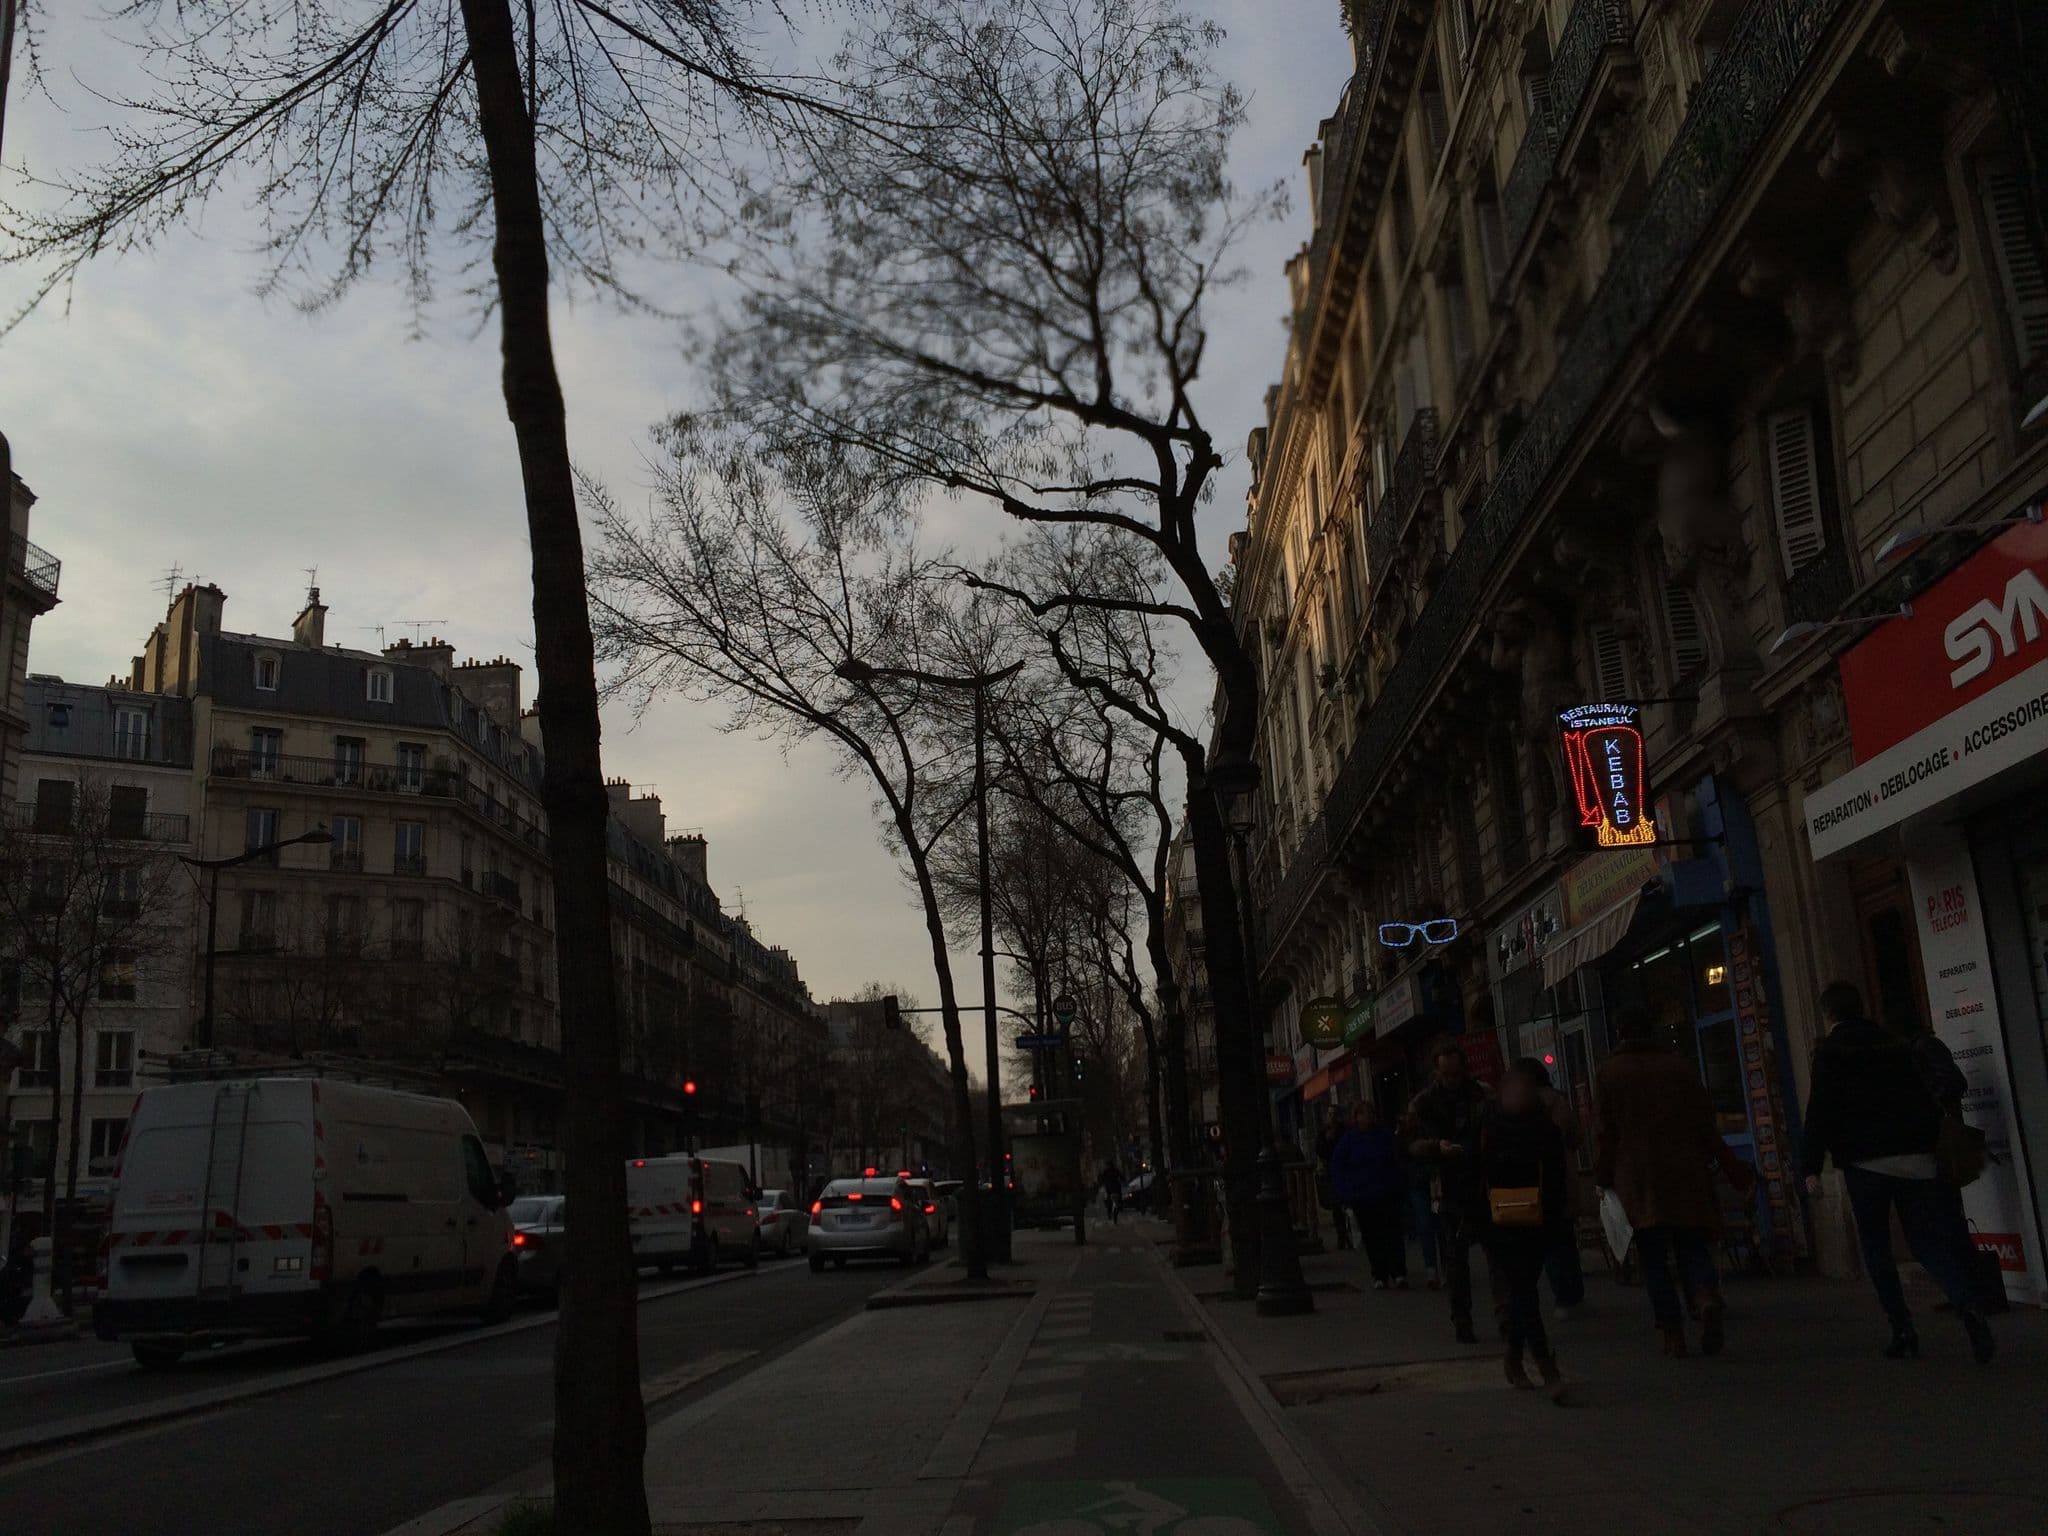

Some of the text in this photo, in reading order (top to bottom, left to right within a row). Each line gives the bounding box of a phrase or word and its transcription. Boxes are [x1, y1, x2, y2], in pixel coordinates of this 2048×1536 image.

[1560, 703, 1638, 722] RESTAURANT
[1570, 716, 1632, 728] ISTANBUL
[1604, 738, 1631, 824] KEBAB
[1813, 790, 1872, 835] REPARATION
[1881, 747, 1950, 801] DEBLOCAGE
[1928, 885, 1965, 919] PARIS
[1931, 910, 1968, 933] TELECOM
[1939, 960, 1977, 979] REPARATION
[1945, 1002, 1984, 1019] DEBLOCAGE
[1952, 1045, 1994, 1061] CCESSOIRES
